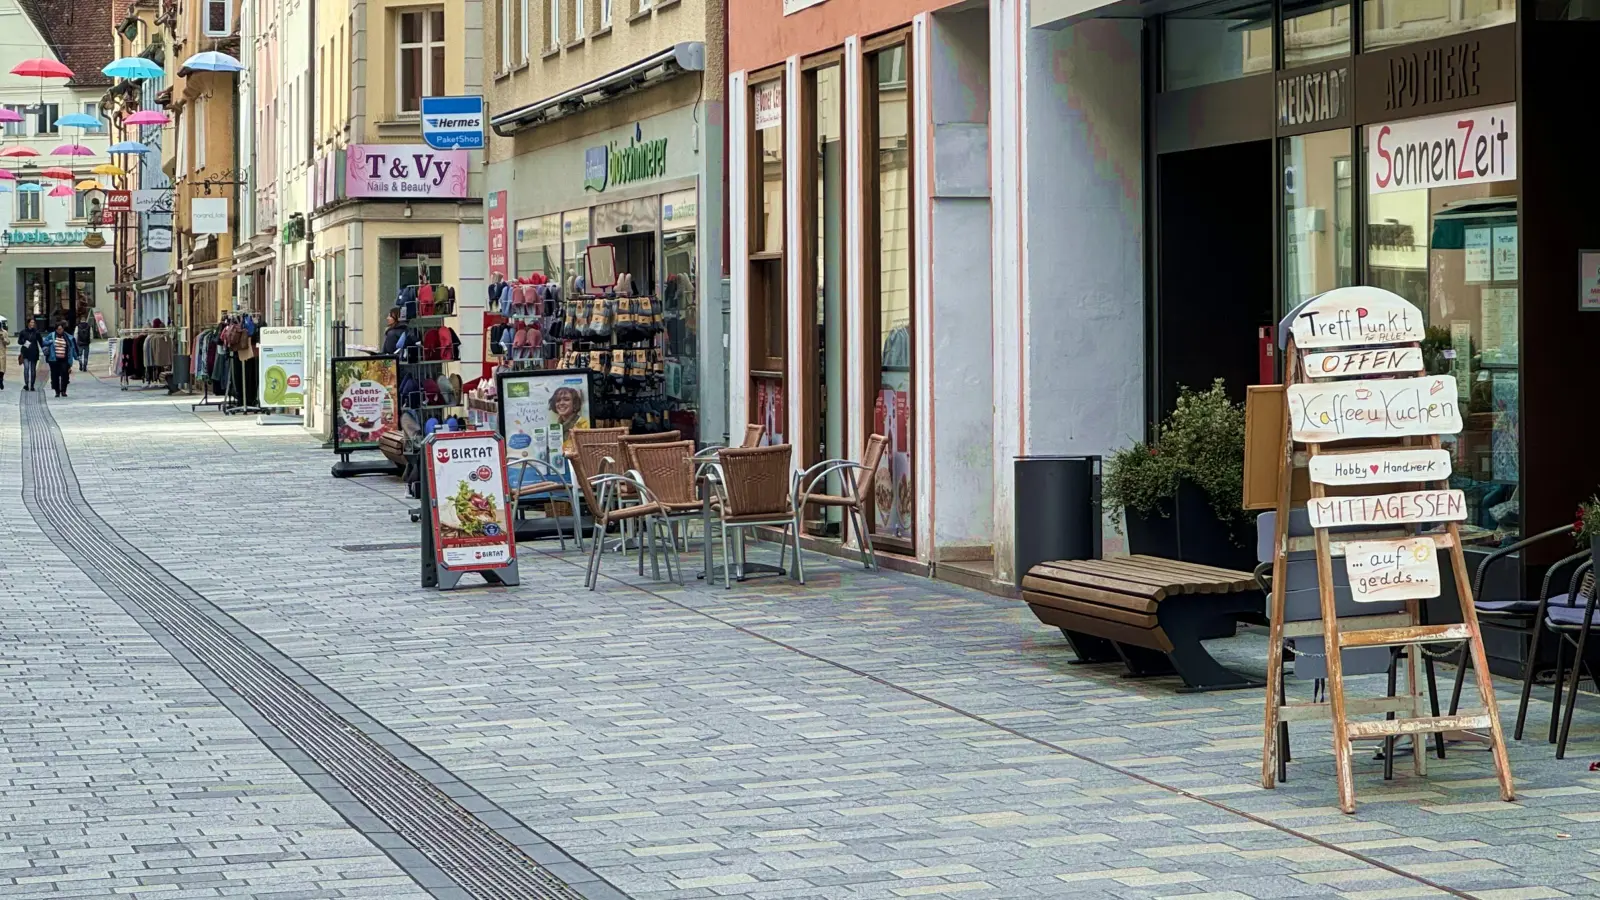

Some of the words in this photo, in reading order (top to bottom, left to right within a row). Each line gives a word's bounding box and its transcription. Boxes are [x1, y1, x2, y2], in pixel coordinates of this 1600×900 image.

[1385, 41, 1480, 110] APOTHEKE
[1278, 68, 1348, 126] NEUSTADT
[439, 118, 480, 128] Hermes
[436, 135, 480, 144] PaketShop
[1376, 116, 1509, 188] SonnenZeit
[366, 154, 386, 178] T
[389, 157, 409, 178] &
[412, 154, 451, 186] Vy
[367, 181, 389, 192] Nails
[391, 181, 399, 192] &
[401, 182, 432, 194] Beauty
[110, 195, 129, 203] LEGO
[1321, 351, 1409, 373] OFFEN
[353, 395, 379, 403] Elixier
[451, 447, 493, 459] BIRTAT
[1335, 463, 1367, 478] Hobby
[1383, 461, 1436, 474] Handwerk
[1316, 493, 1462, 525] MITTAGESSEN
[1370, 545, 1406, 570] auf
